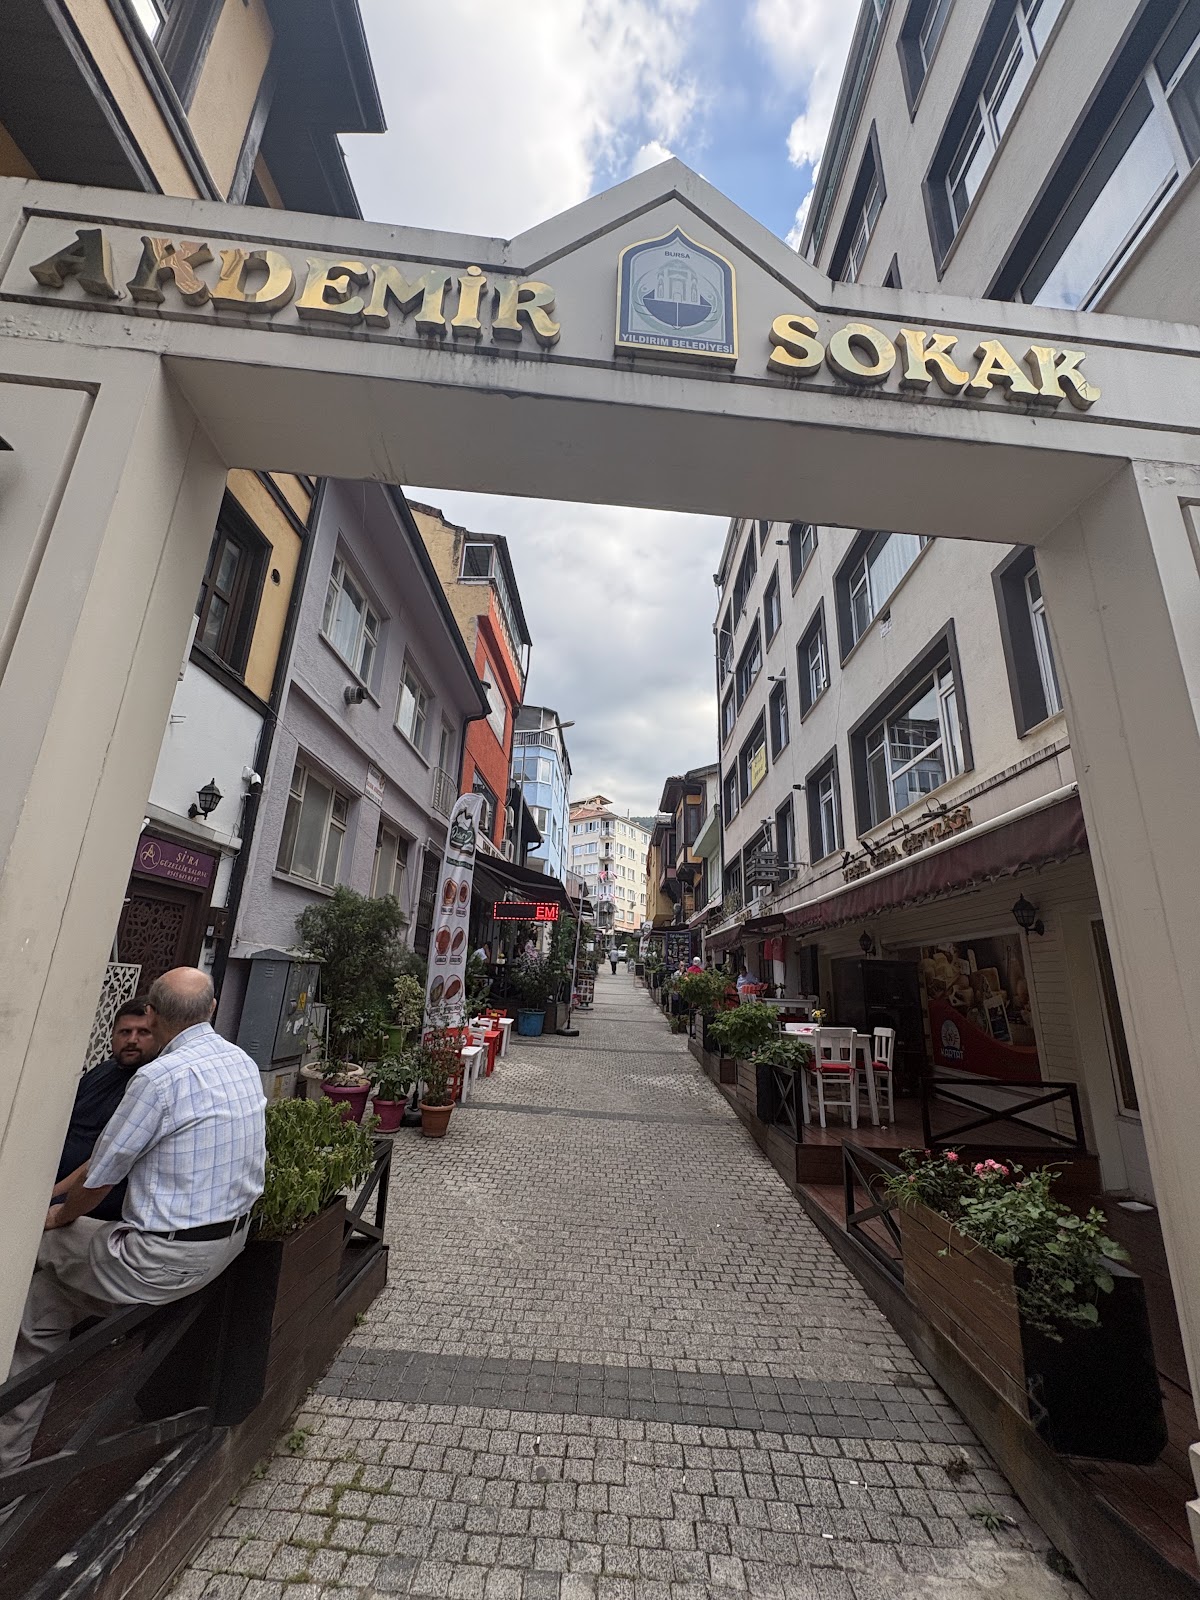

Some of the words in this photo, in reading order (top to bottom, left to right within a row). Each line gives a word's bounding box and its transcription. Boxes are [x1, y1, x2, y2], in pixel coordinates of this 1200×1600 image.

[664, 250, 691, 259] BURSA
[29, 228, 561, 348] AKDEMİR
[767, 313, 1101, 411] SOKAK
[622, 333, 669, 346] YILDIRIM
[671, 339, 733, 354] BELEDİYESİ
[536, 906, 555, 918] EM
